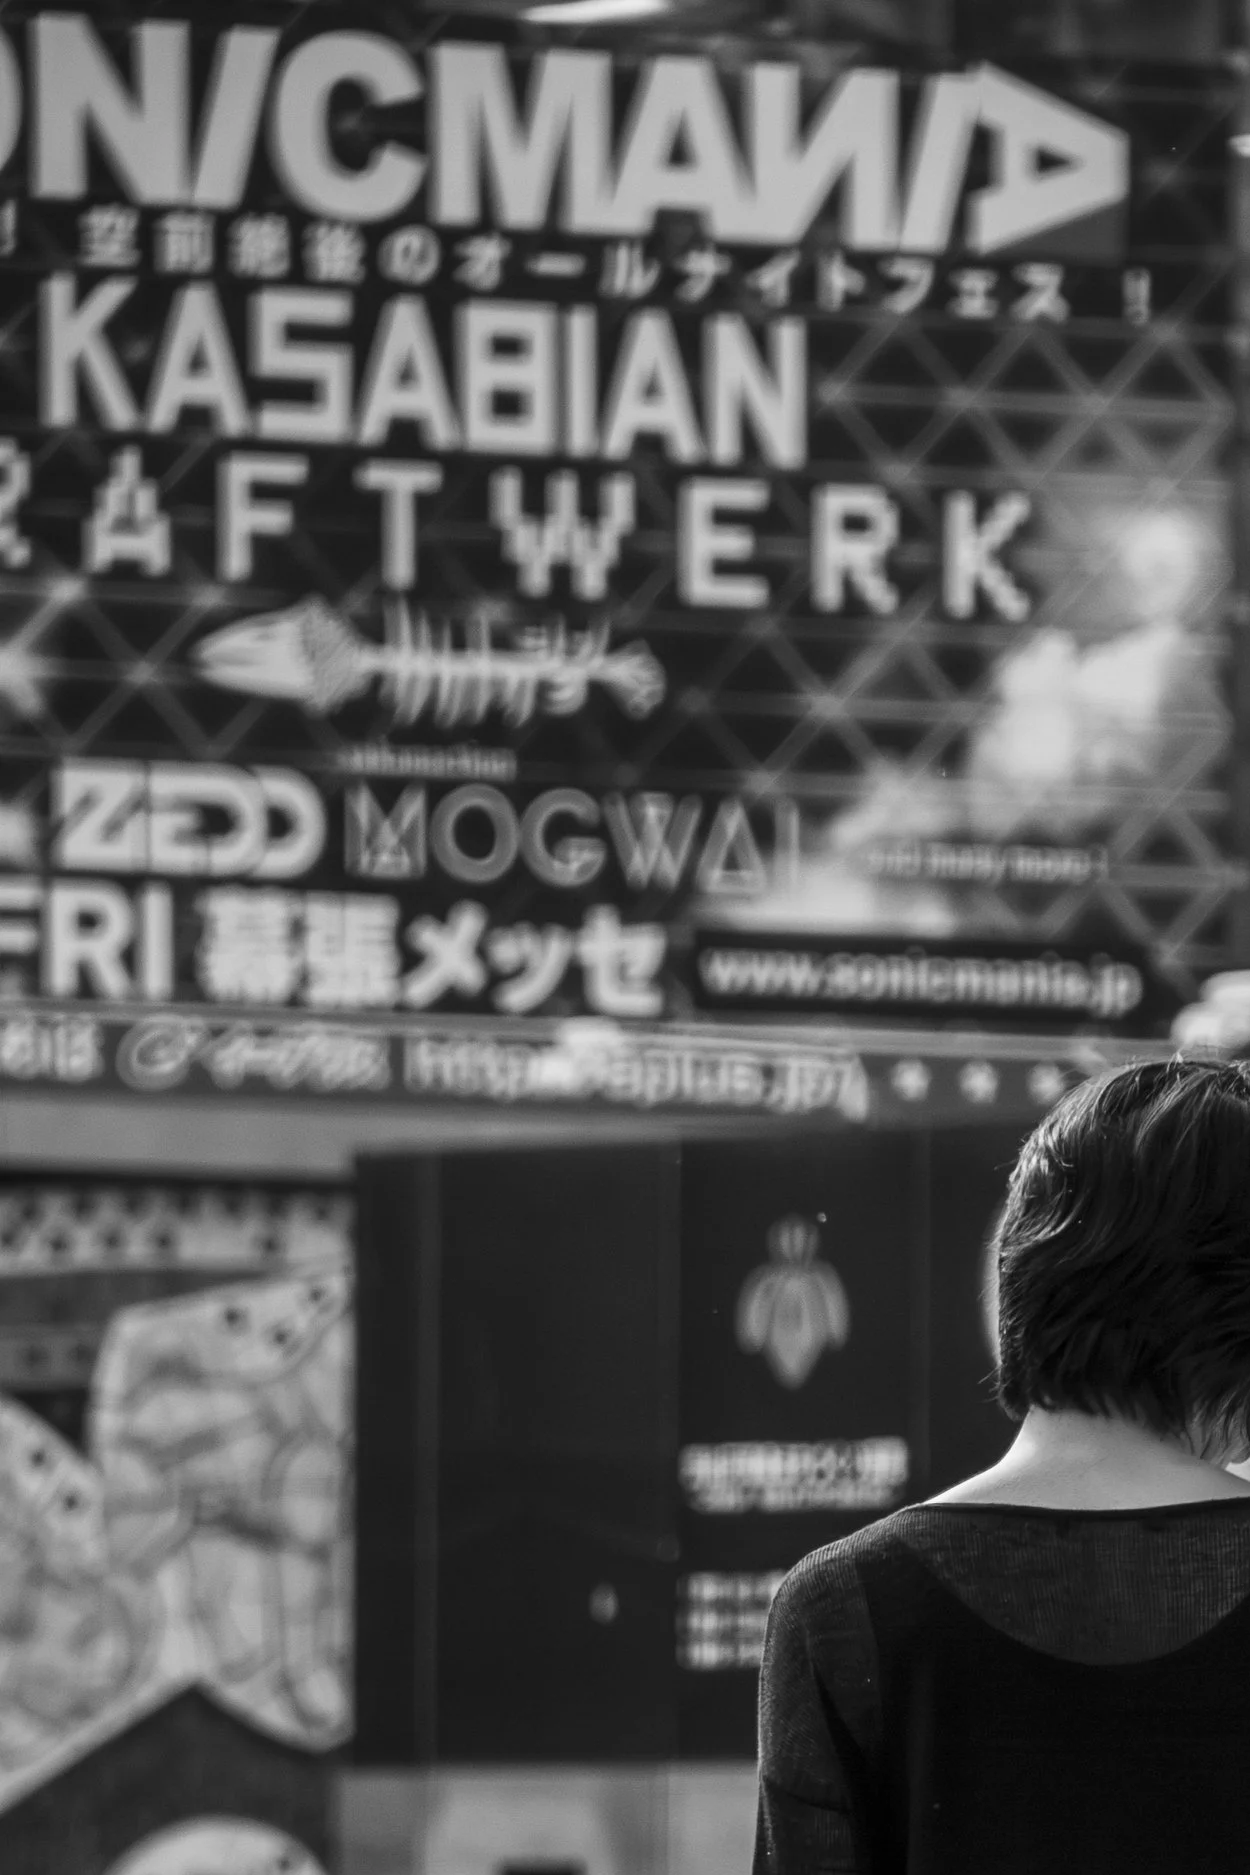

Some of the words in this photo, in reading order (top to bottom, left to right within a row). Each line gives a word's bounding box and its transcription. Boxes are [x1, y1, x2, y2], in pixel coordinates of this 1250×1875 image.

[38, 272, 808, 470] KASABIAN
[52, 757, 326, 880] ZEDD
[344, 782, 800, 895] MOGWAI
[702, 946, 1144, 1020] www.sonicmania.jp
